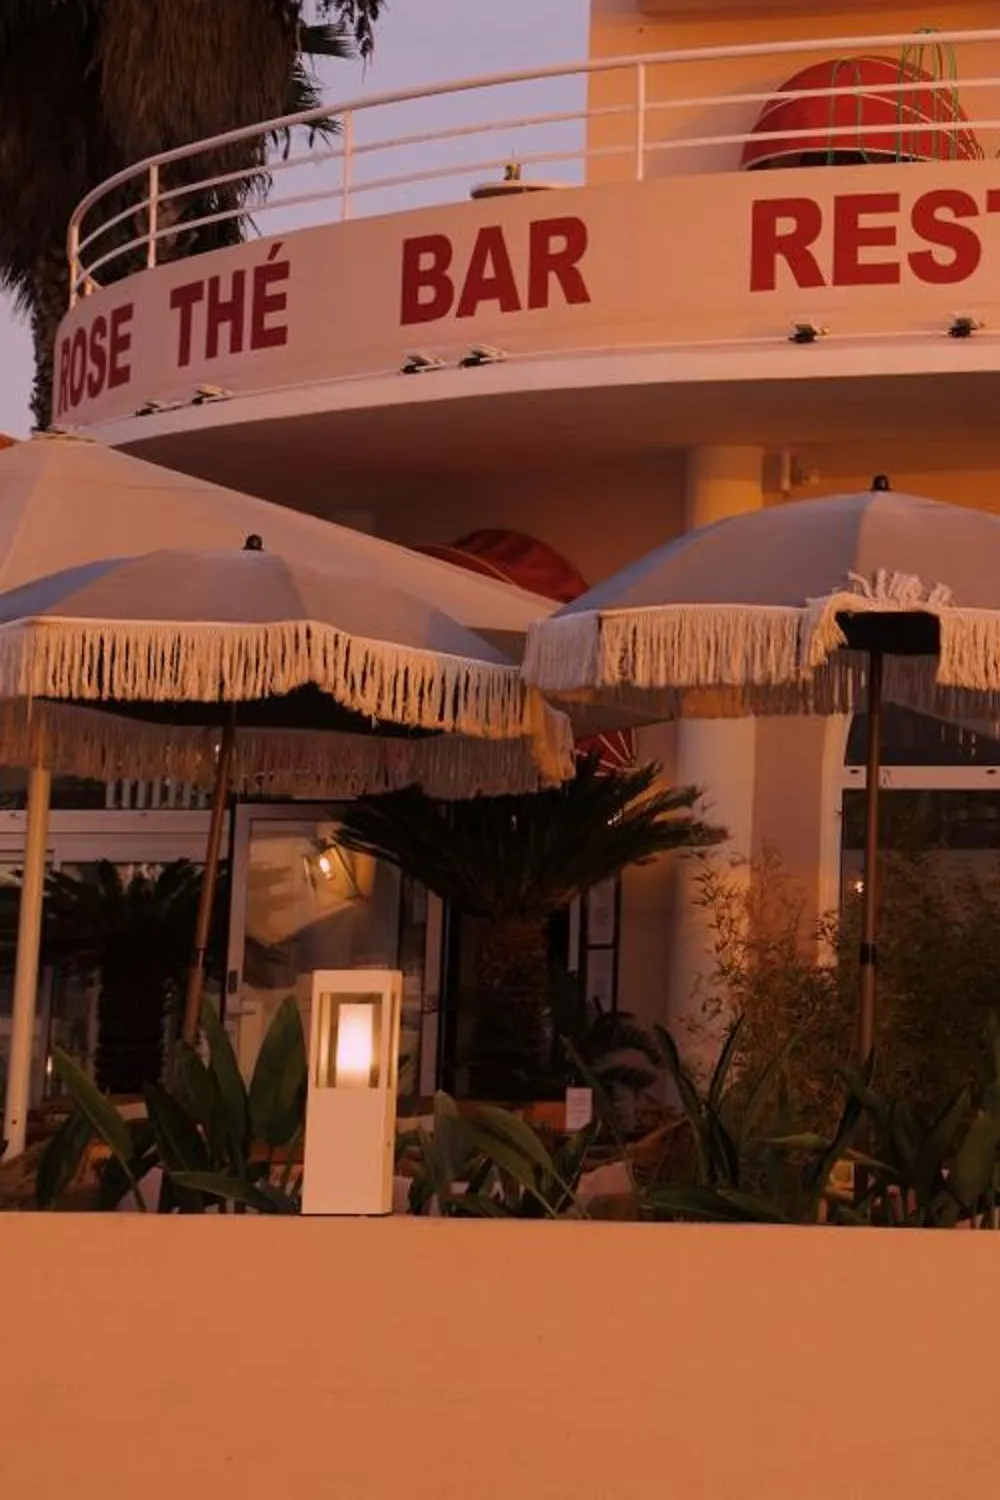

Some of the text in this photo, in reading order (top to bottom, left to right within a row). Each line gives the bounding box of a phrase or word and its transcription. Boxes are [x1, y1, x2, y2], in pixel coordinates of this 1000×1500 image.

[57, 302, 133, 417] ROSE
[169, 243, 290, 367] THÉ
[400, 217, 591, 326] BAR
